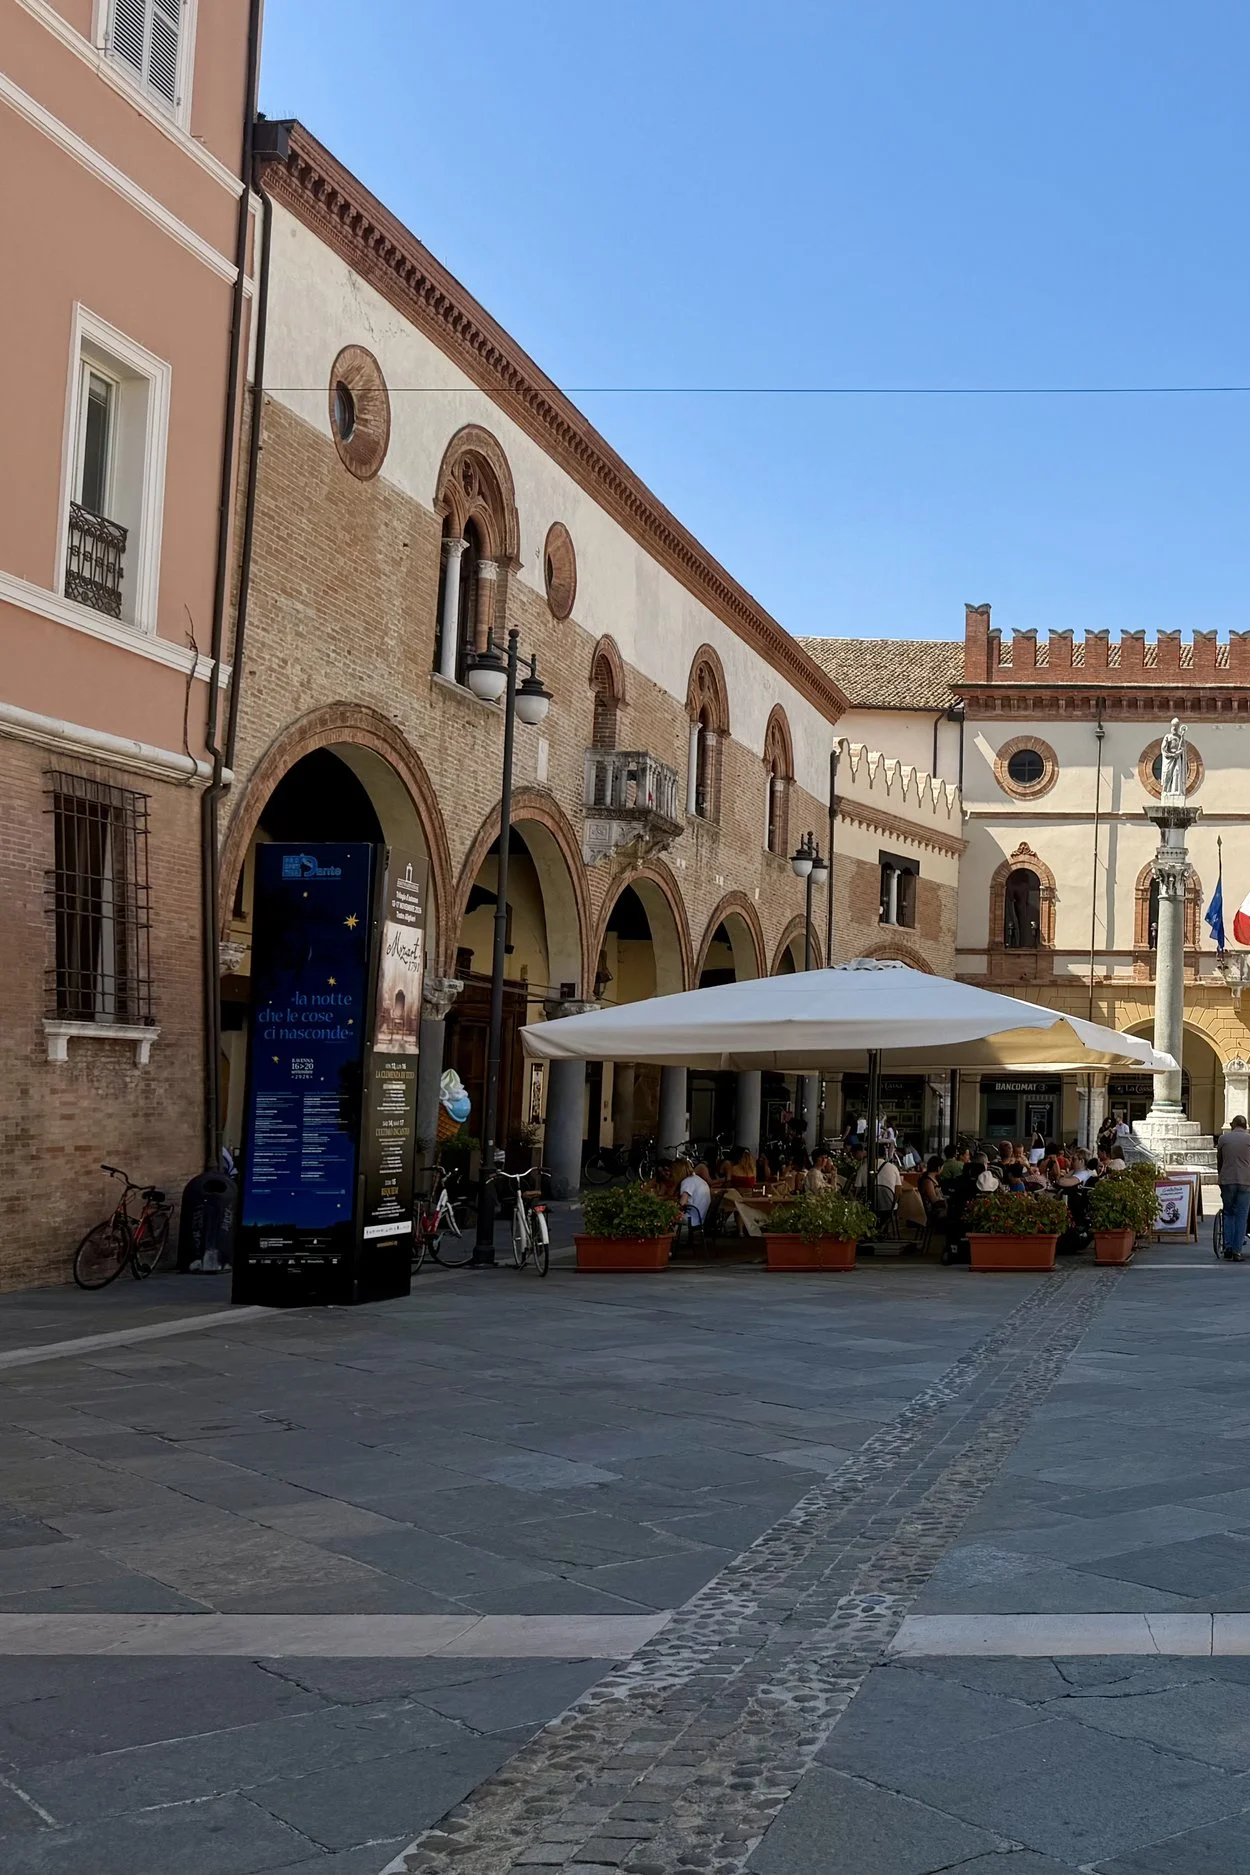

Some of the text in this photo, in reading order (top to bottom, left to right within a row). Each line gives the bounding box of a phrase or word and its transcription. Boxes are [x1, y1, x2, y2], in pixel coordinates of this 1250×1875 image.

[312, 993, 352, 1005] notte
[258, 1008, 334, 1022] che le cose
[264, 1025, 276, 1039] ci
[995, 1083, 1037, 1091] BANCOMAT
